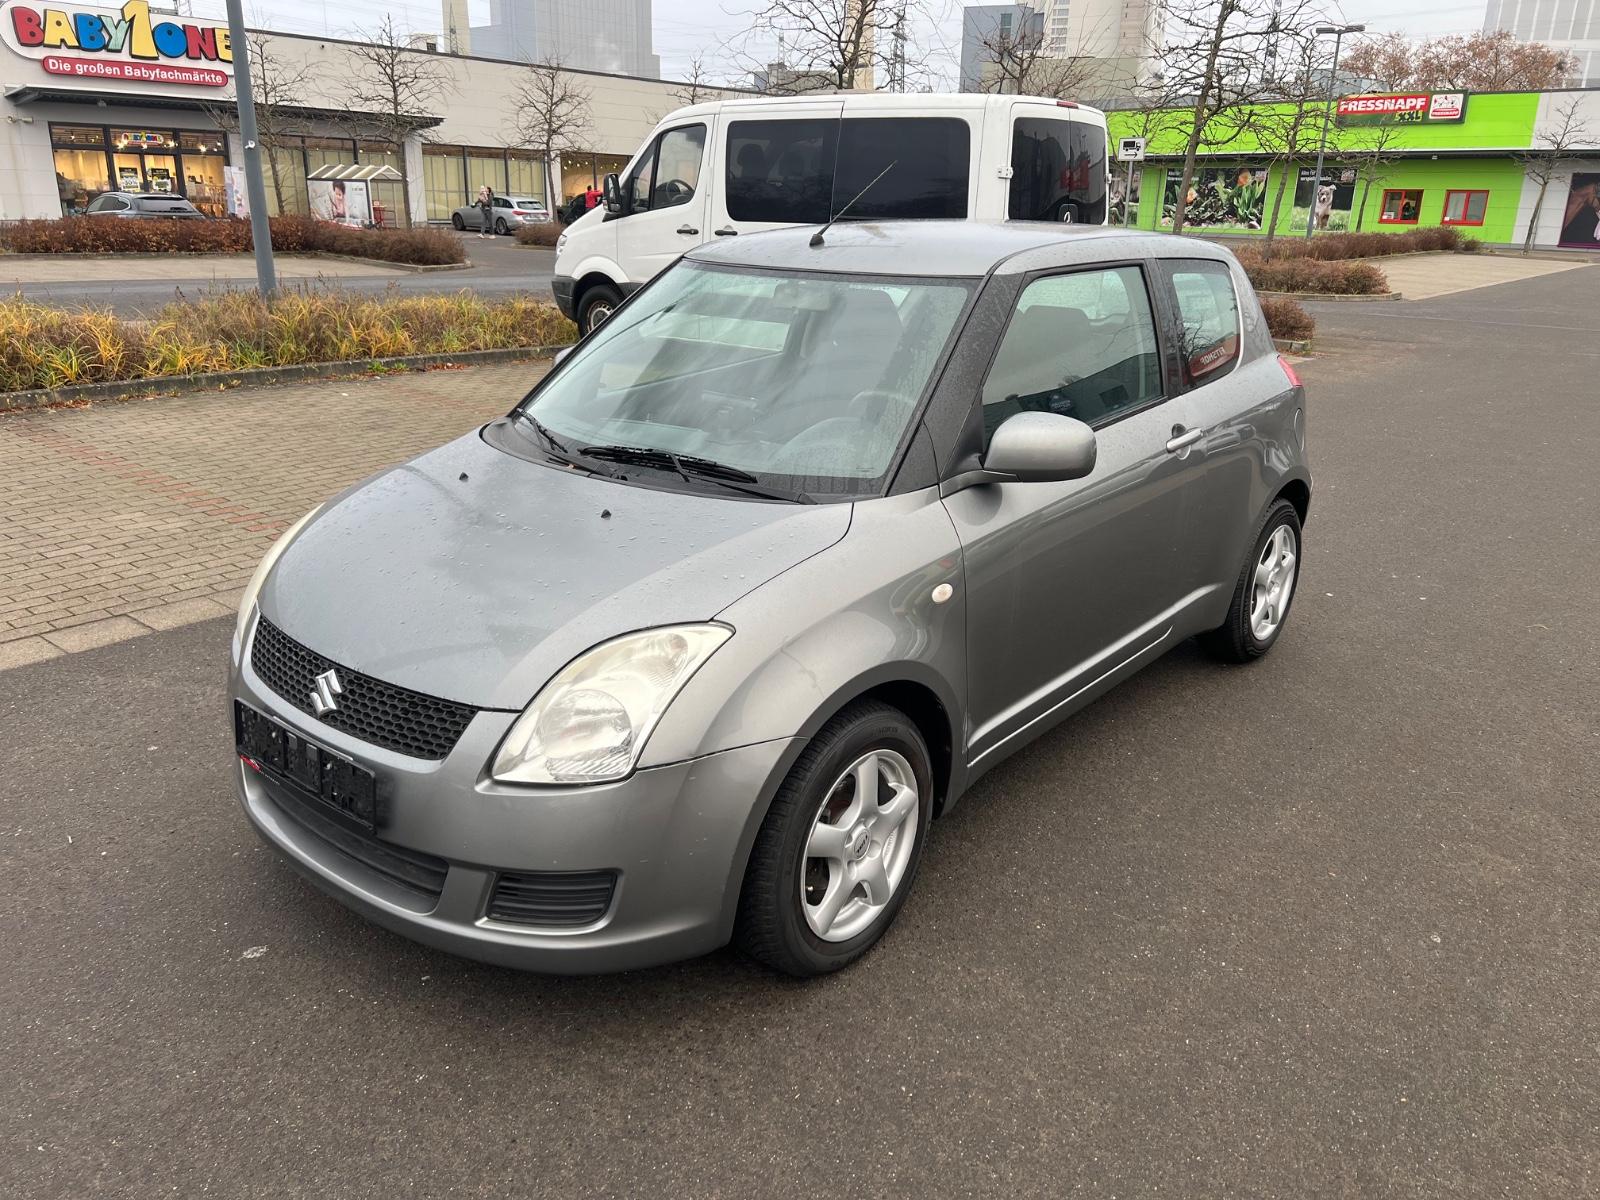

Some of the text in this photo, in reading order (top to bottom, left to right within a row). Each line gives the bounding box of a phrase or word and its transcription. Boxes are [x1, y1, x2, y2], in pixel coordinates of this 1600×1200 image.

[48, 59, 223, 84] Die großen Babyfachmärkte
[1338, 97, 1427, 112] FRESSNAPF
[1397, 112, 1421, 122] XXL
